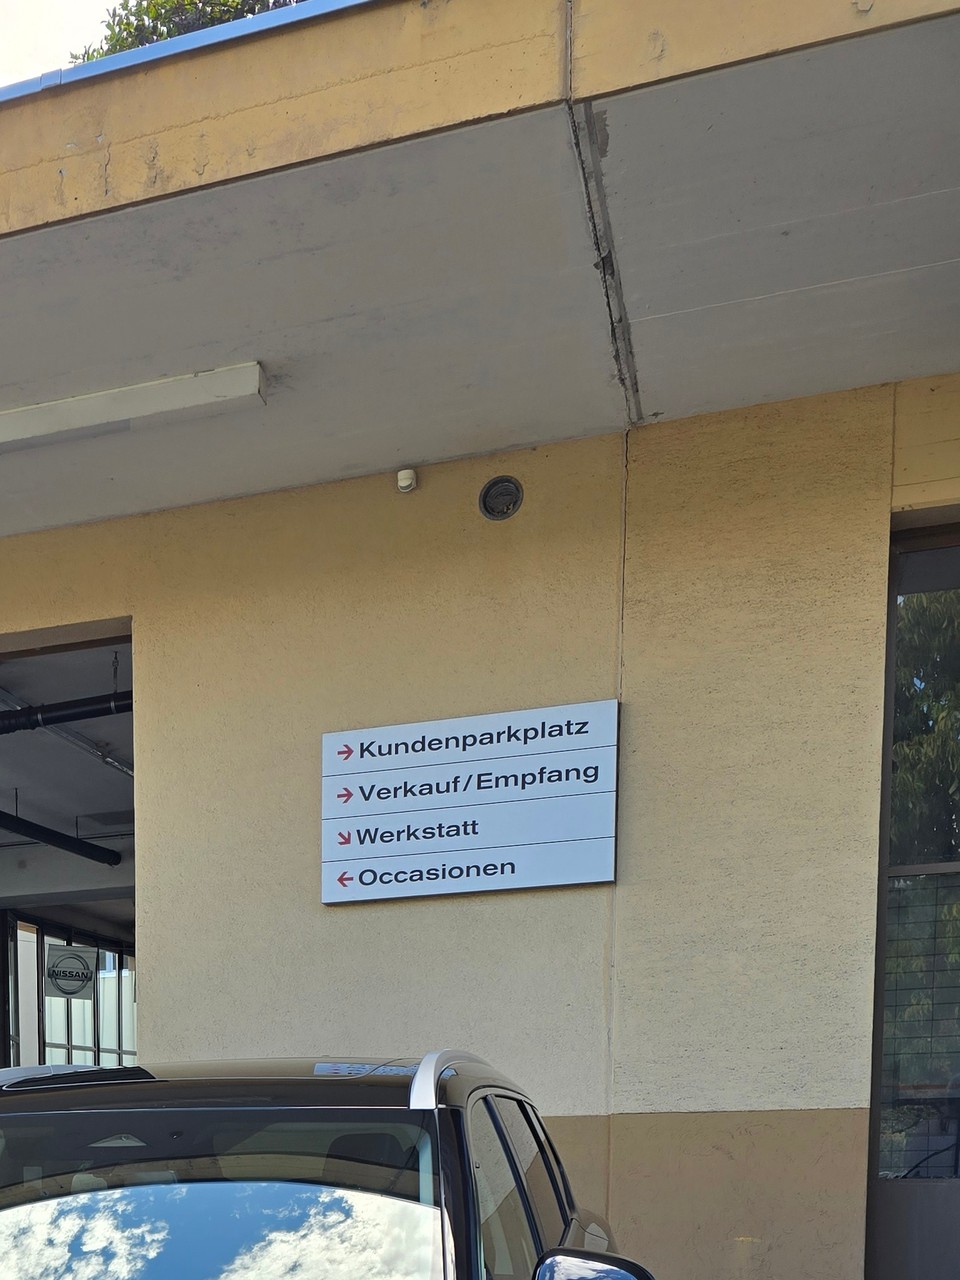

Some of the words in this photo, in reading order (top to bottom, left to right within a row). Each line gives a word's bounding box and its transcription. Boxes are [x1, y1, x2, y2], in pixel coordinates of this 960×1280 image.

[359, 719, 589, 759] Kundenparkplatz
[358, 764, 600, 801] Verkauf/Empfang
[356, 820, 479, 845] Werkstatt
[358, 860, 516, 887] Occasionen
[51, 969, 89, 979] NISSAN
